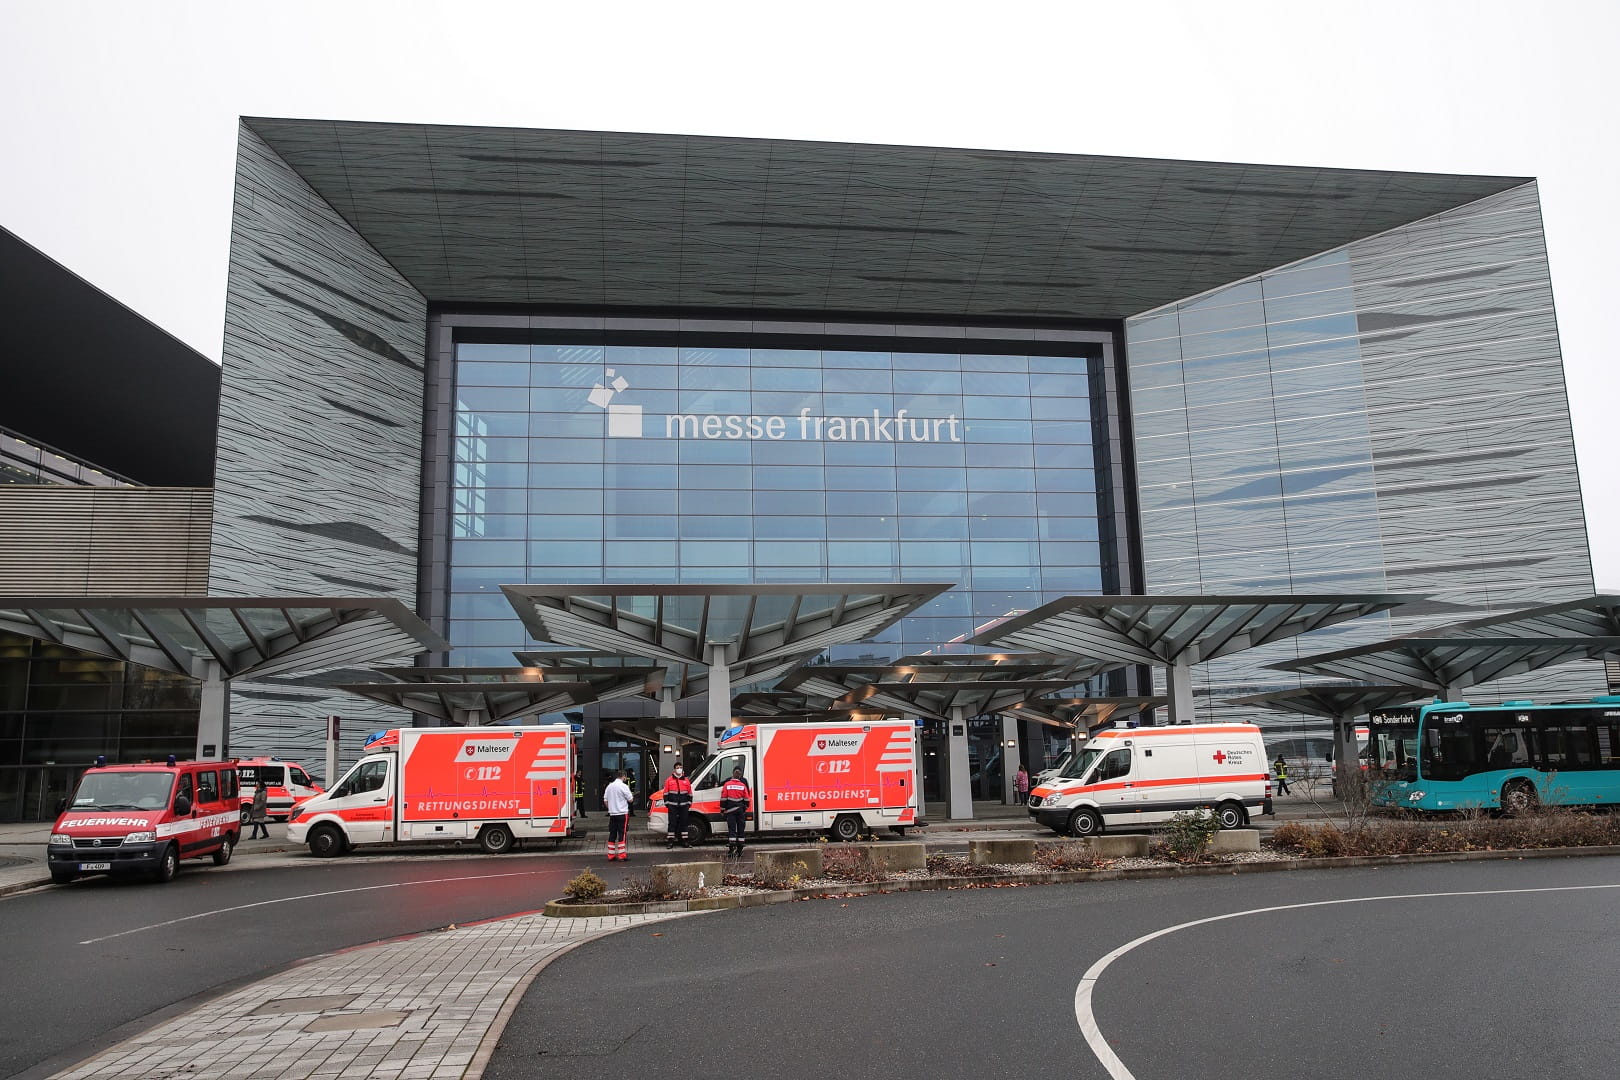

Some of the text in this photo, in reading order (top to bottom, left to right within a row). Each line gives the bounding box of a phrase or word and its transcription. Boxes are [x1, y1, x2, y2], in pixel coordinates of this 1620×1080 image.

[665, 407, 961, 443] messe frankfurt
[1383, 714, 1415, 724] Sonderfahrt
[477, 745, 510, 753] Malteser
[242, 769, 255, 778] 112
[477, 766, 501, 780] 112
[829, 760, 850, 774] 112
[777, 789, 871, 801] RETTUNGSDIENST
[417, 799, 521, 812] RETTUNGSDIENST
[58, 818, 149, 831] FEUERWEHR
